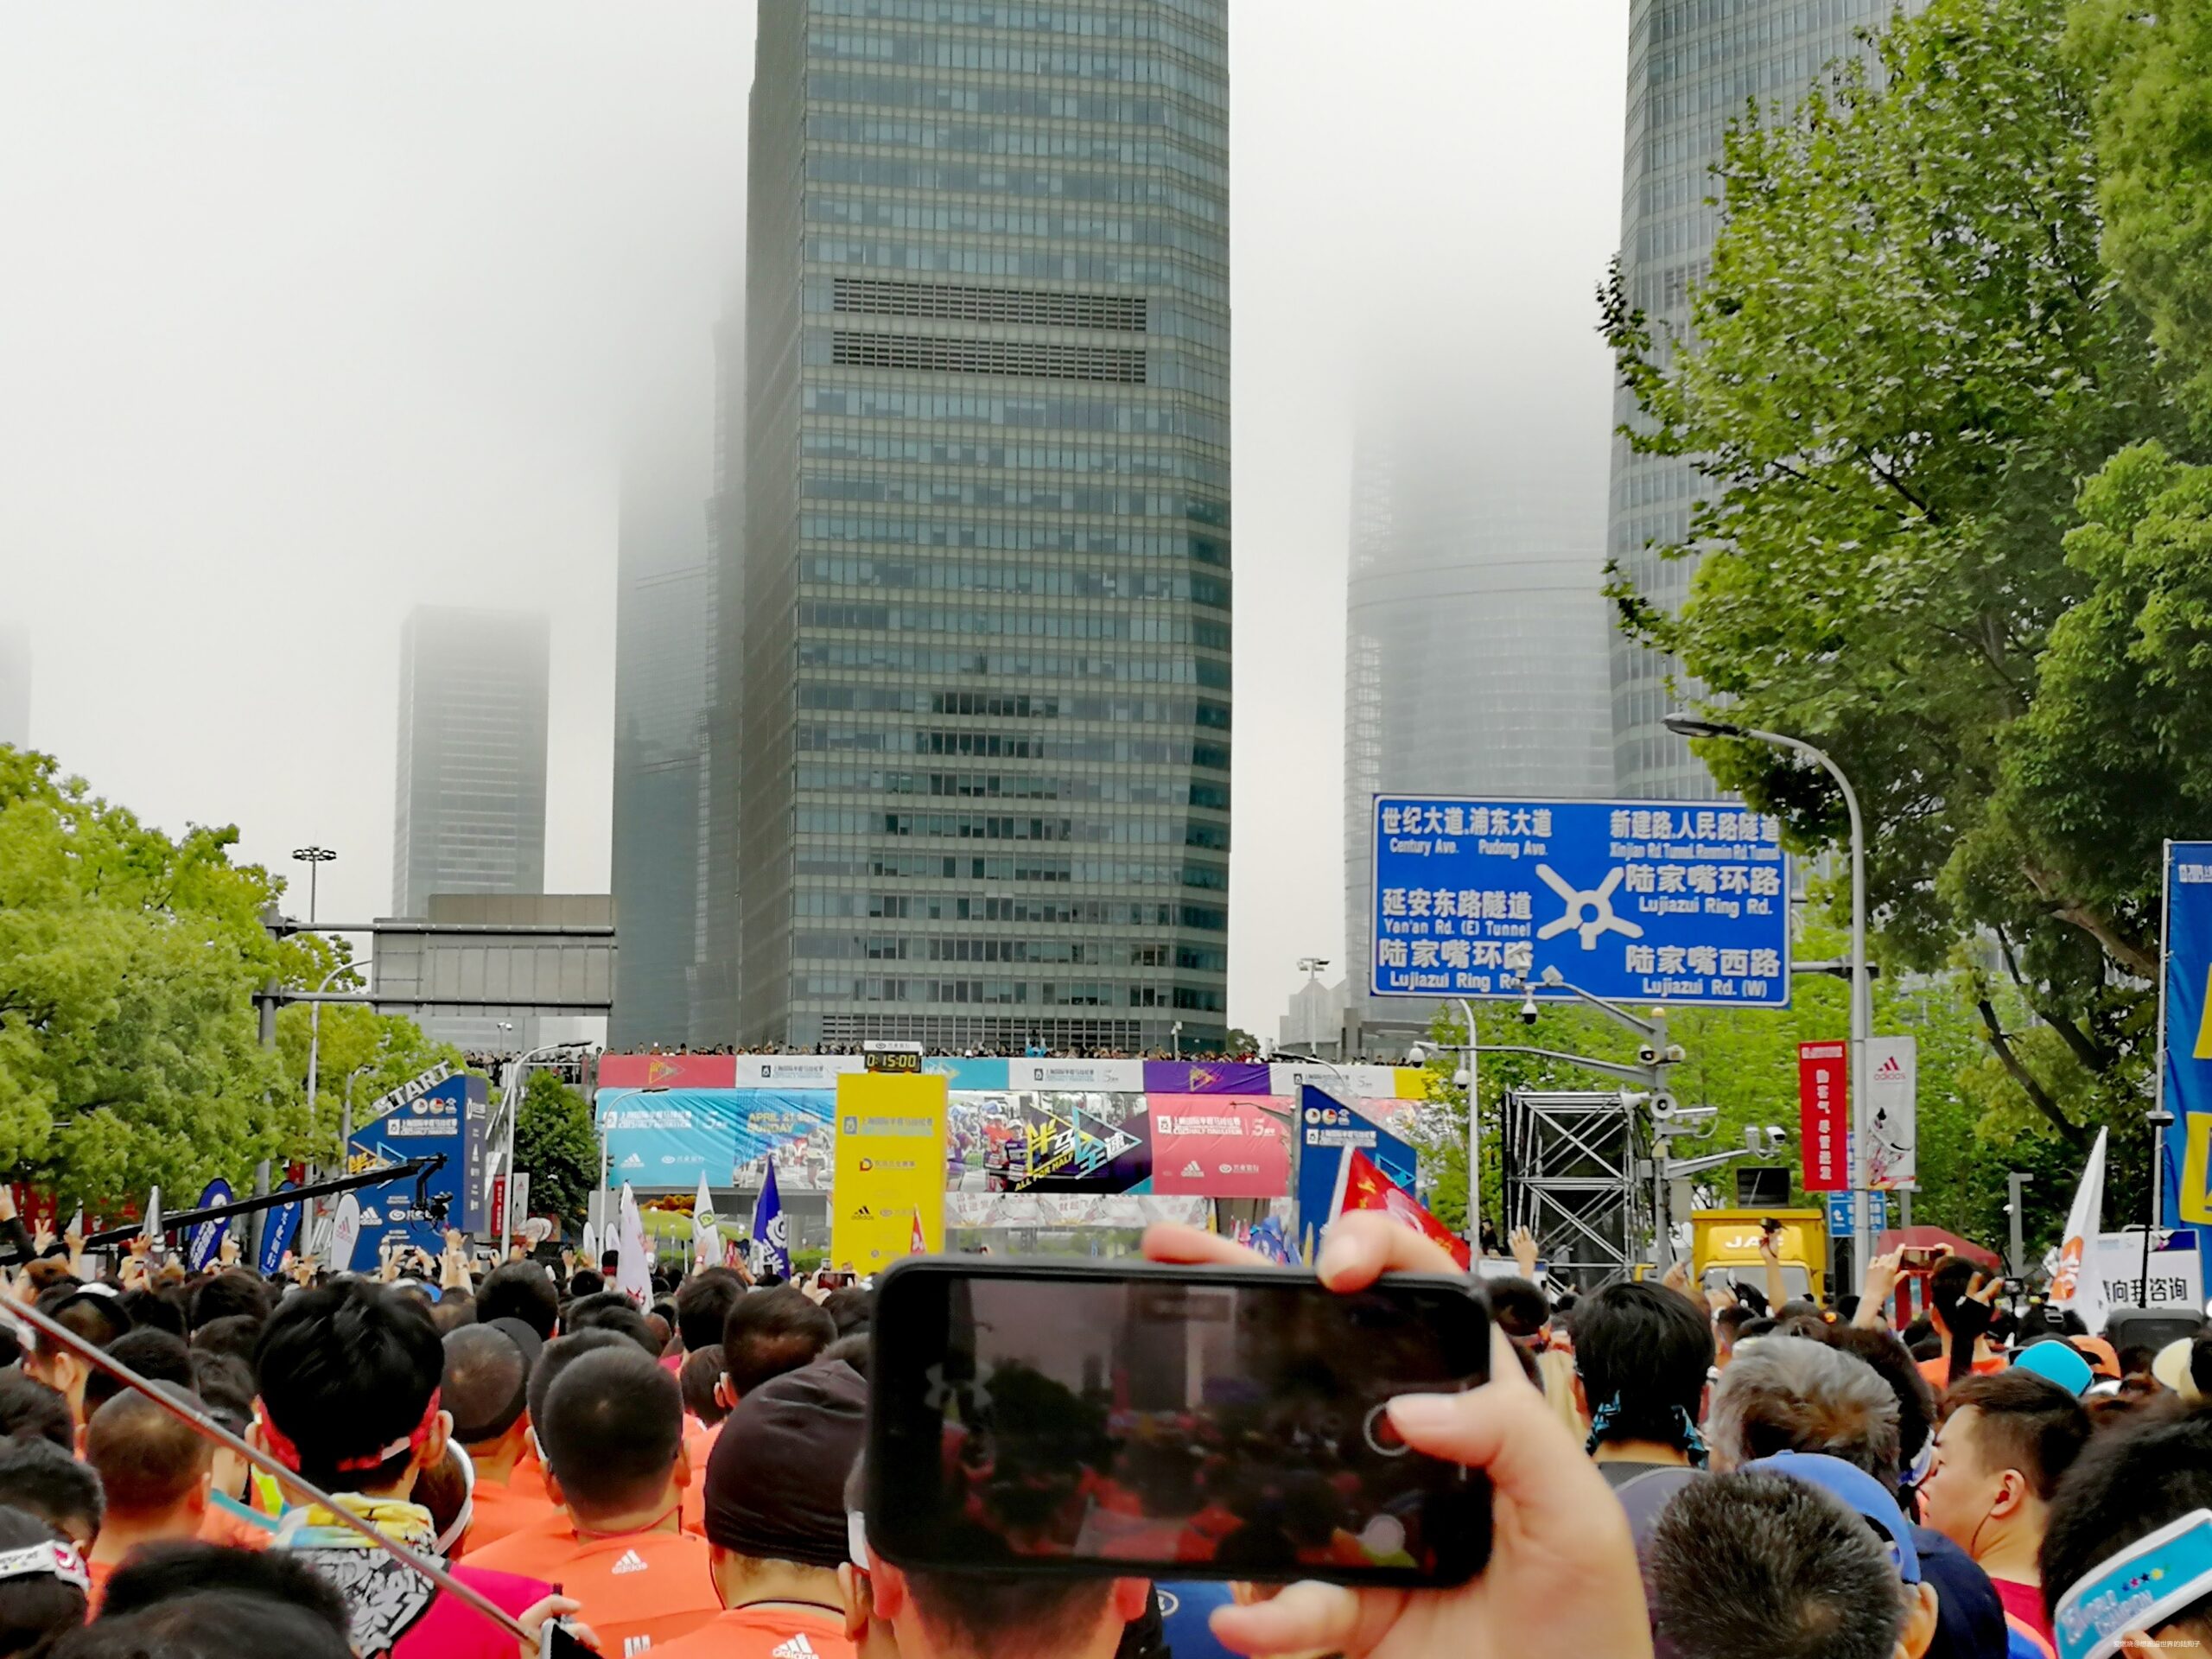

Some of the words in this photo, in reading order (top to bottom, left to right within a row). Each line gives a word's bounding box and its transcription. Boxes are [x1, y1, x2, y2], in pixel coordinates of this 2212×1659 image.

[1389, 837, 1432, 857] Century
[1434, 838, 1460, 854] Ave.
[1478, 839, 1520, 860] Pudong
[1522, 840, 1549, 856] Ave.
[1625, 863, 1781, 896] 陆家嘴环路
[1382, 887, 1533, 920] 延安东路隧道
[1639, 896, 1700, 916] Lujiazui
[1705, 897, 1740, 918] Ring
[1746, 898, 1773, 914] Rd.
[1383, 918, 1429, 935] Yan'an
[1434, 918, 1455, 935] Rd.
[1460, 919, 1480, 936] (E)
[1485, 920, 1531, 938] Tunnel
[1625, 944, 1781, 977] 陆家嘴西路
[1390, 970, 1450, 990] Lujiazui
[1456, 972, 1491, 992] Ring
[1643, 977, 1704, 997] Lujiazui
[1711, 979, 1738, 995] Rd.
[1742, 979, 1768, 998] (W)
[373, 1060, 450, 1113] START
[748, 1112, 779, 1122] APRIL
[747, 1122, 794, 1134] SUNDAY
[1014, 1176, 1033, 1192] ALL
